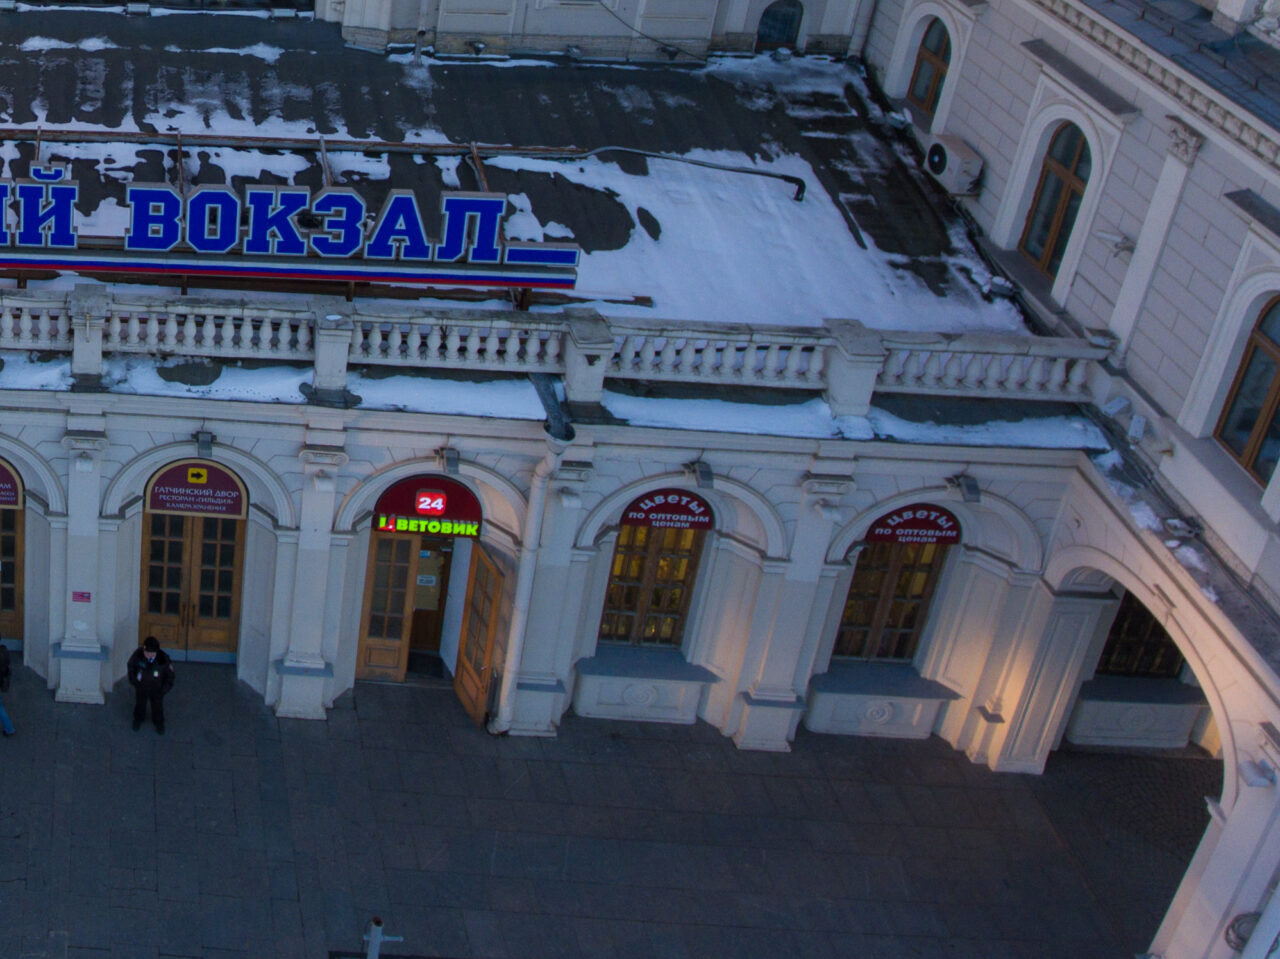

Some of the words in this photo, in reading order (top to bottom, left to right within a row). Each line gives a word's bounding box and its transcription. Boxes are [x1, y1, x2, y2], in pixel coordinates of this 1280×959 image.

[124, 182, 508, 264] ВОКЗАЛ
[154, 486, 213, 496] ГАТЧИНСКИЙ
[214, 489, 240, 498] ДВОР
[159, 495, 195, 503] РЕСТОРАН
[418, 496, 444, 511] 24
[639, 494, 705, 514] цветы
[649, 512, 710, 523] оптовым
[887, 509, 954, 529] цветы
[378, 515, 480, 536] ЦВЕТОВИК
[874, 527, 893, 535] по
[895, 528, 958, 537] оптовым
